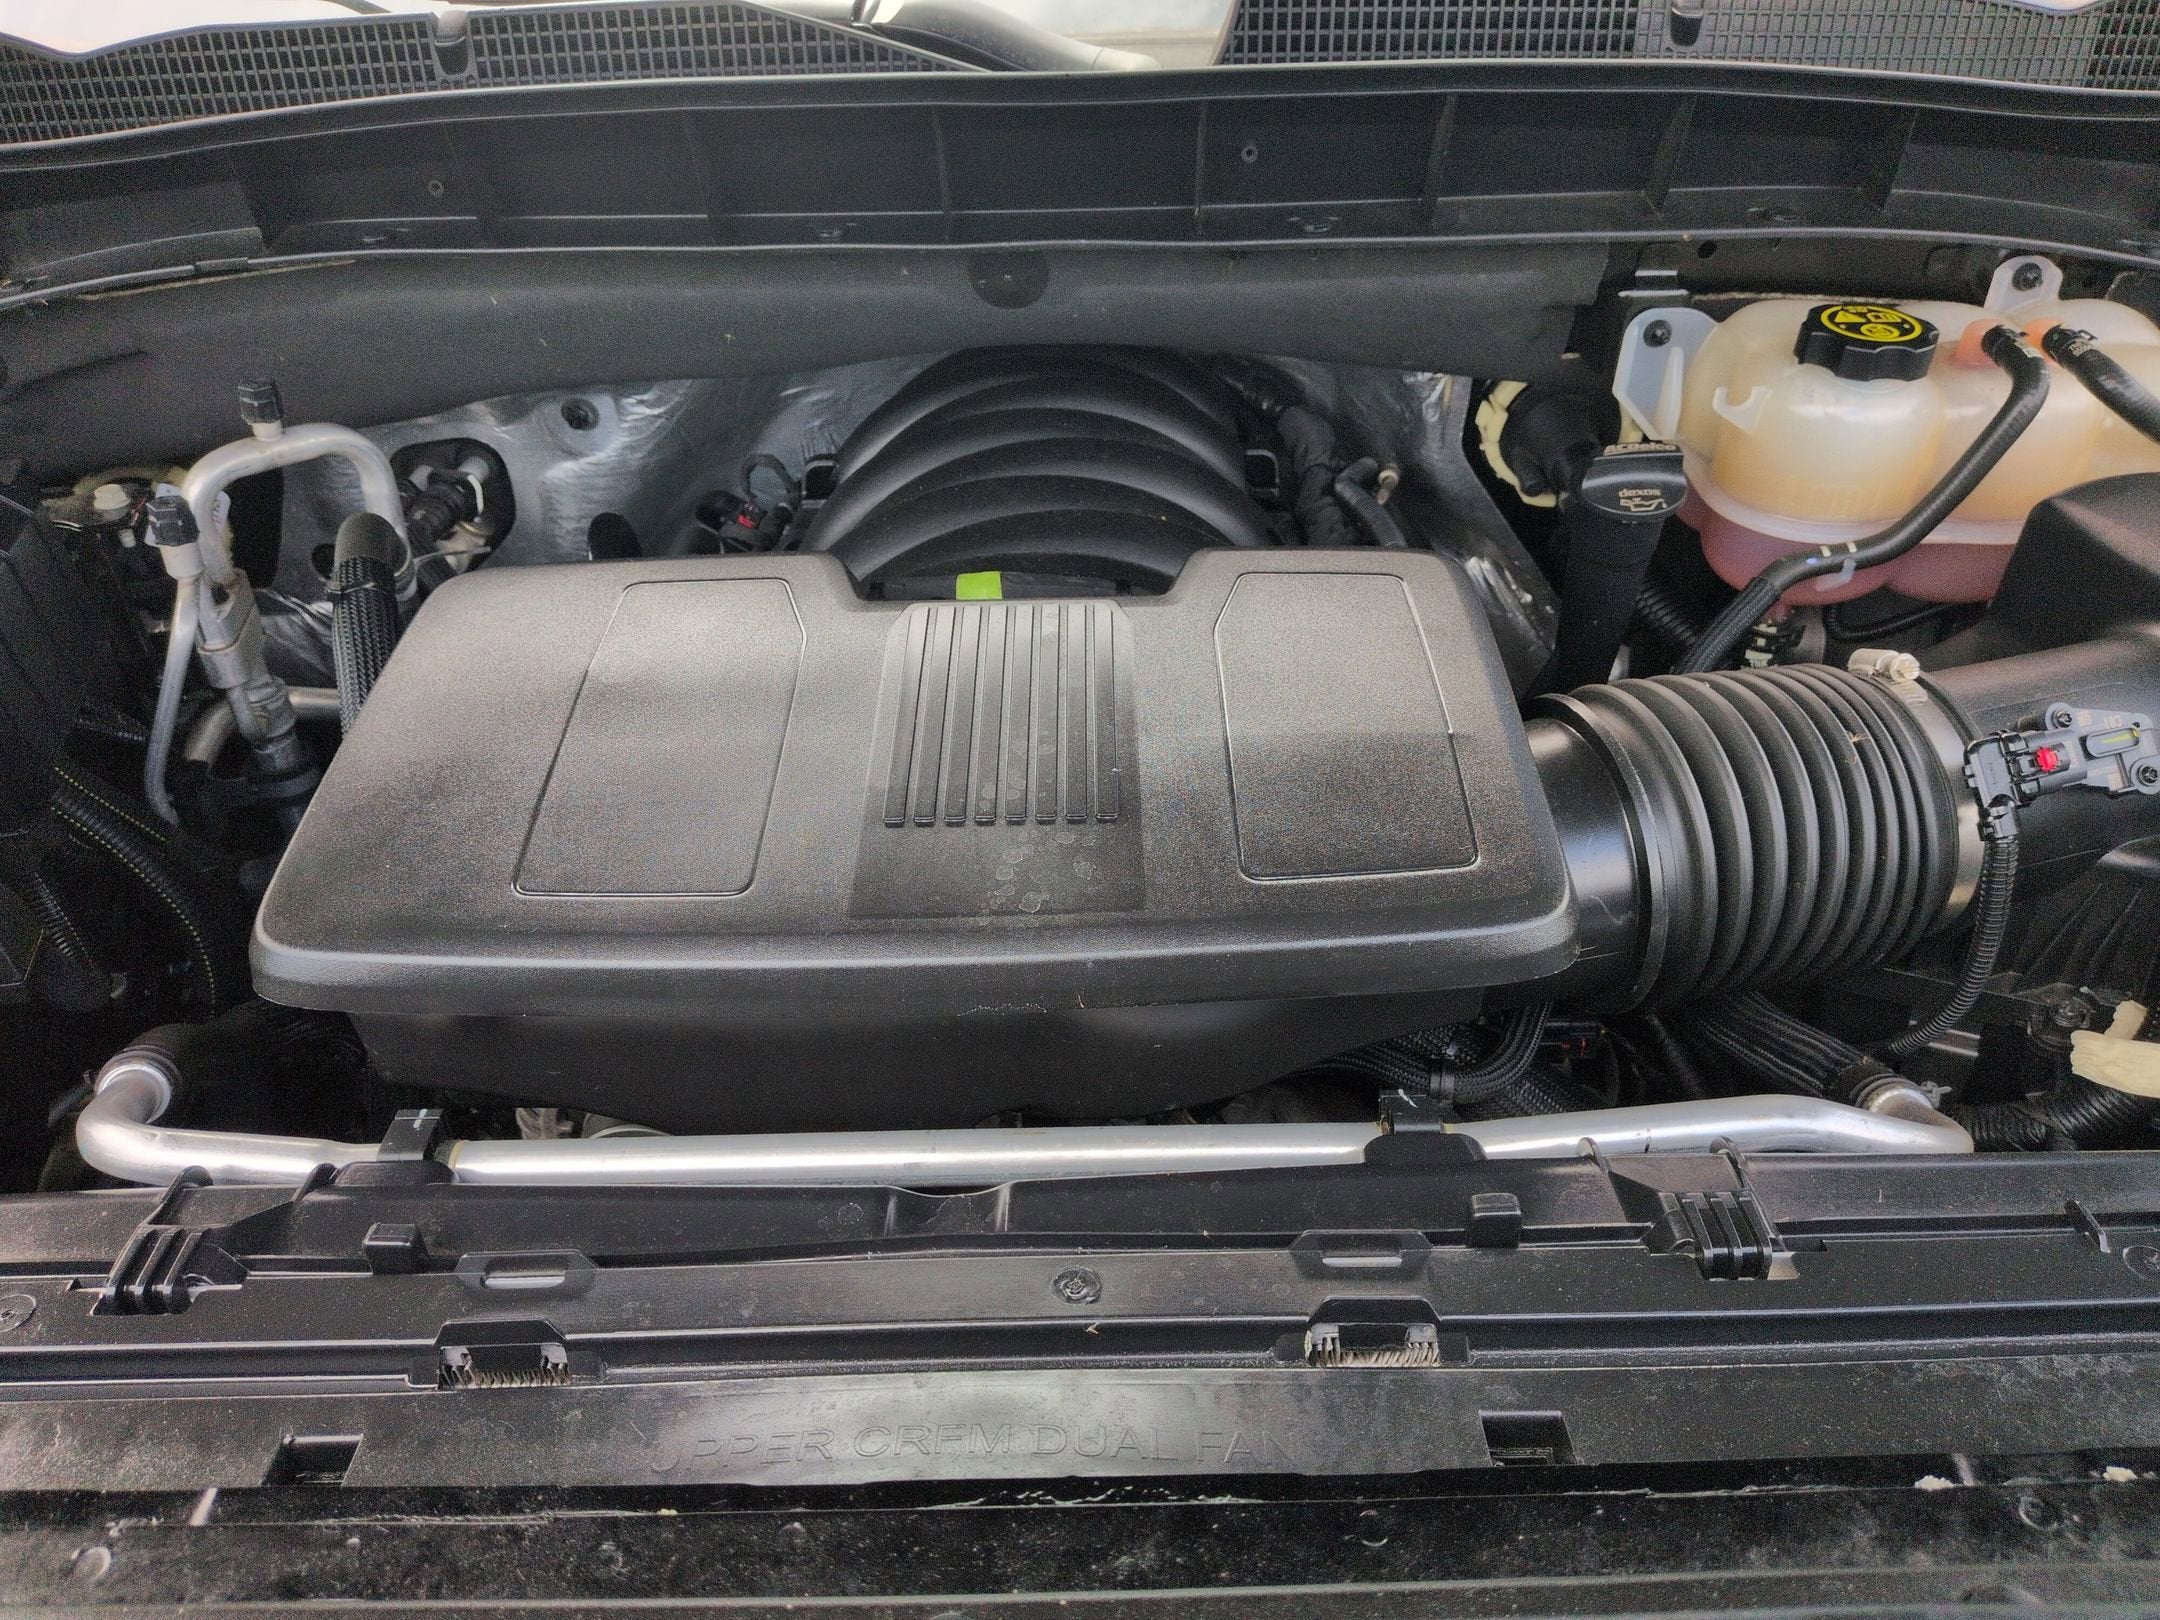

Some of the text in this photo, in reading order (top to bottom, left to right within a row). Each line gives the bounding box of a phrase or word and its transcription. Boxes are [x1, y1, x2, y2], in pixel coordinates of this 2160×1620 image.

[1604, 443, 1677, 455] ACDelco
[652, 1423, 1300, 1472] UPPER CRFM DUAL FAN
